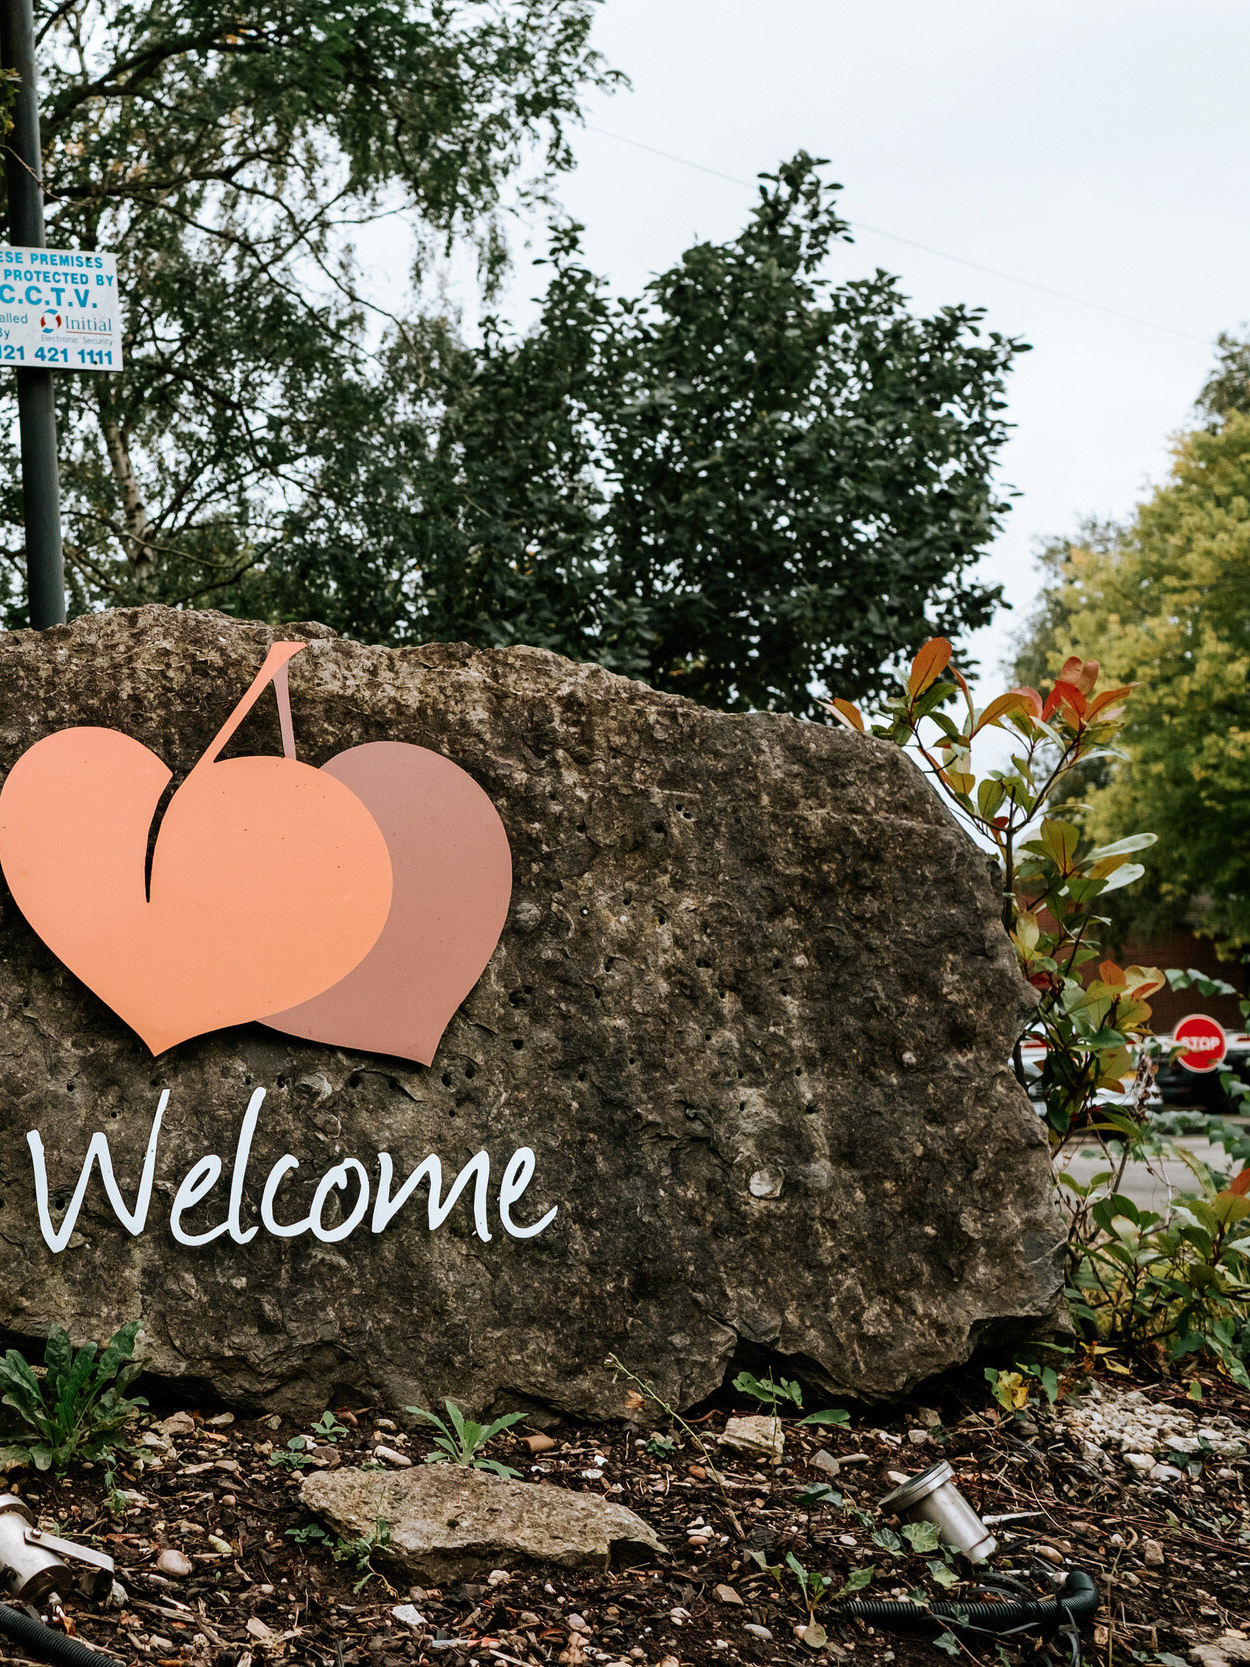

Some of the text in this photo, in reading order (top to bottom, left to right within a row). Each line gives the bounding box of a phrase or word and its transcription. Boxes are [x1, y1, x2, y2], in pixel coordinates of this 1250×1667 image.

[30, 253, 103, 268] PREMISES
[4, 269, 89, 285] PROTECTED
[96, 274, 114, 286] BY
[65, 316, 112, 332] Initial
[41, 334, 113, 346] Electronic Security
[34, 346, 68, 362] 421
[78, 349, 112, 365] 1111
[1181, 1036, 1220, 1051] STOP
[26, 1087, 558, 1253] Welcome
